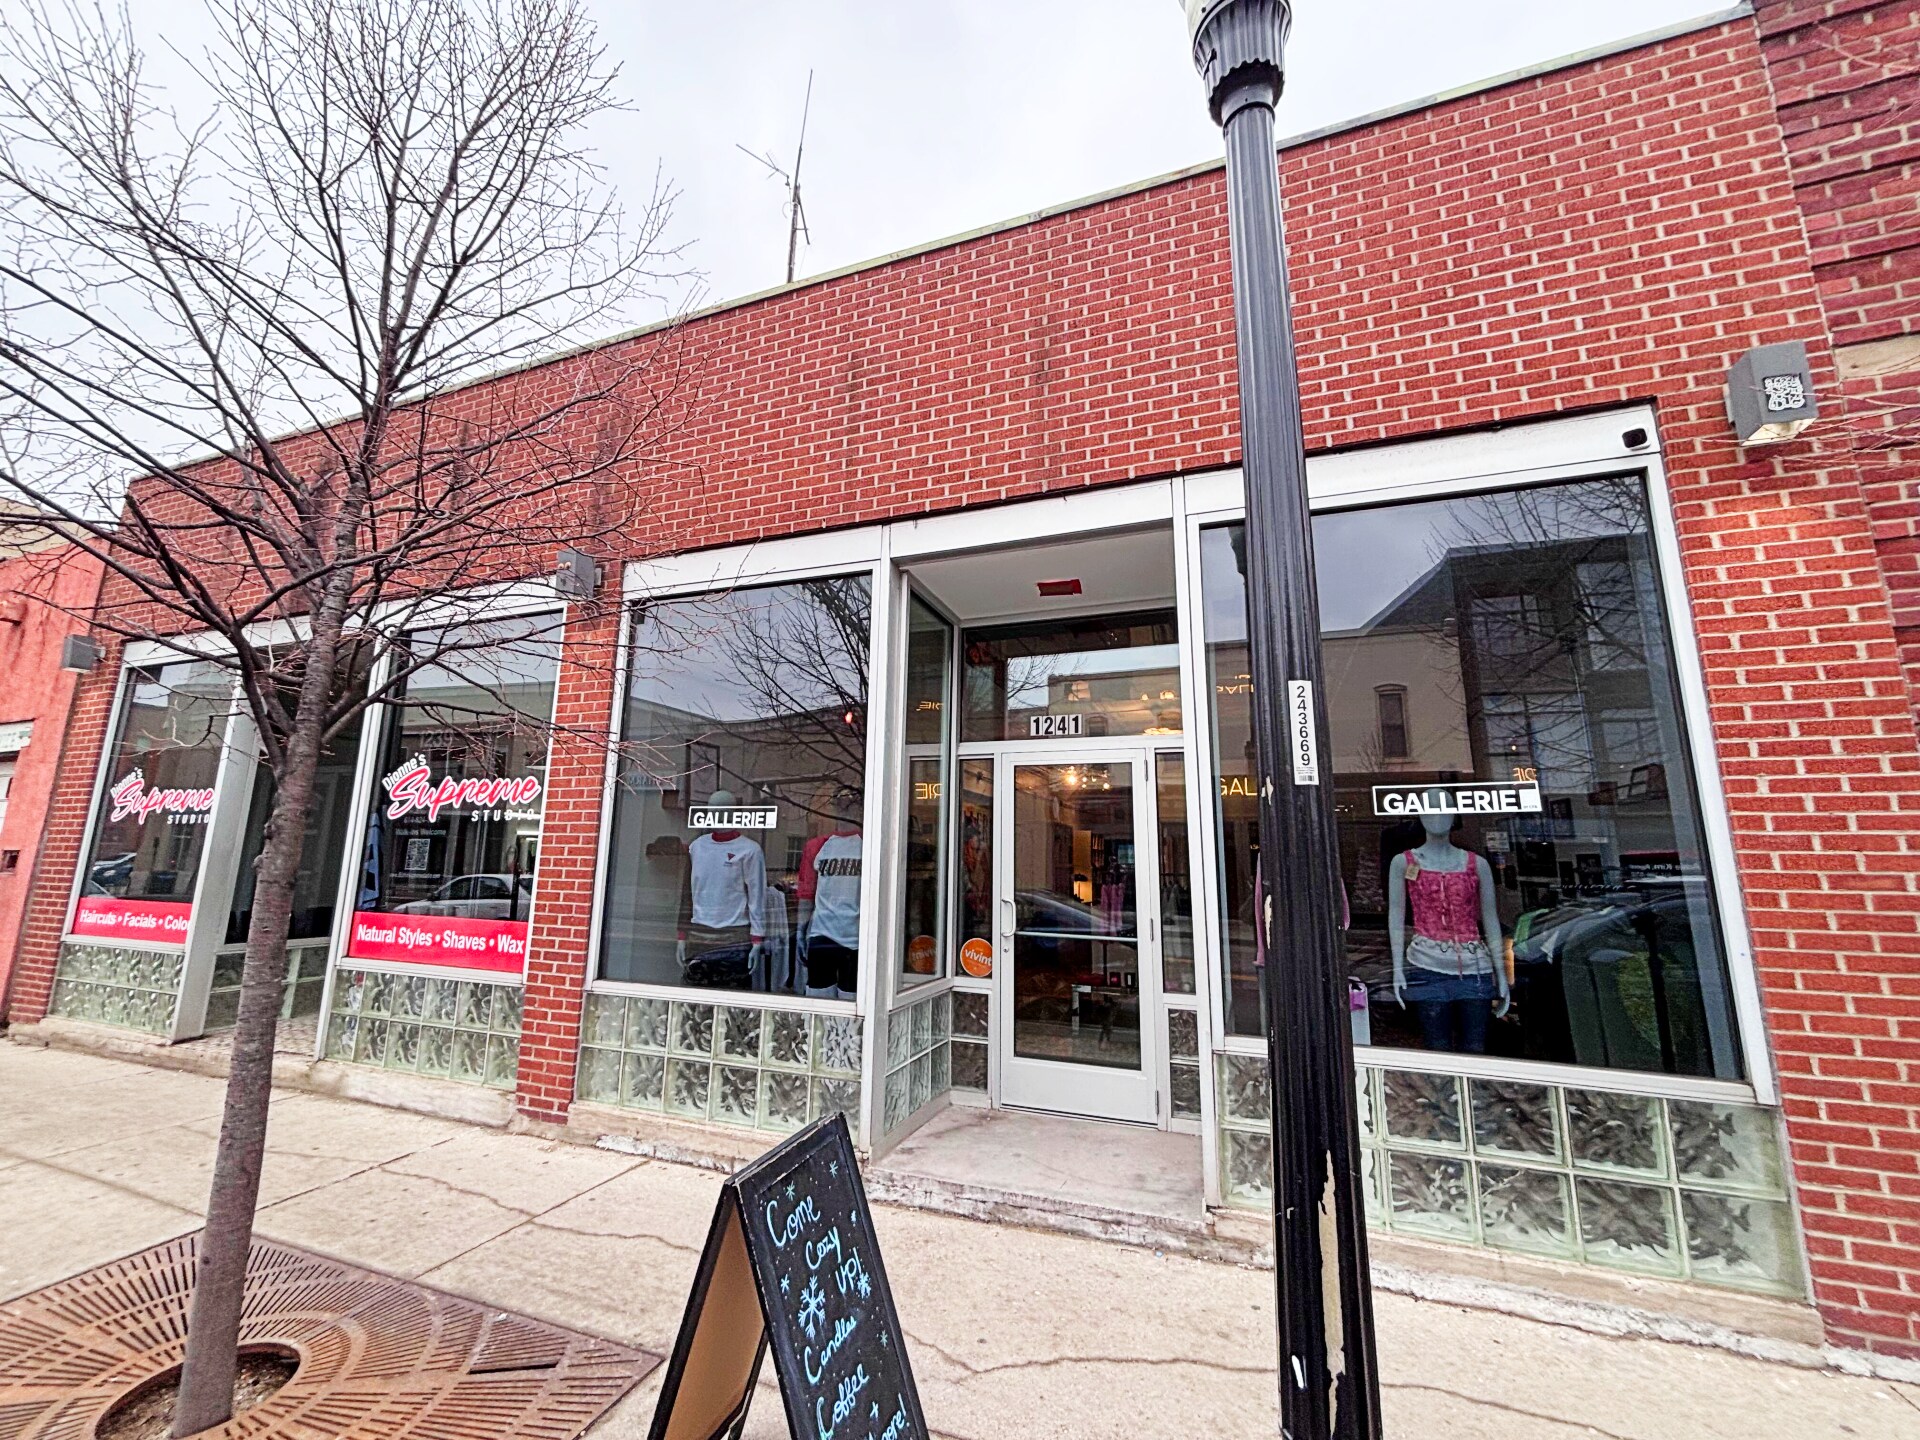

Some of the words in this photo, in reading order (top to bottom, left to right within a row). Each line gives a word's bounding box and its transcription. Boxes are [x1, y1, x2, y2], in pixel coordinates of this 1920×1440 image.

[1033, 715, 1079, 735] 1241
[1296, 685, 1310, 766] 243669
[110, 766, 143, 798] Dionne's
[381, 752, 427, 791] Dionne's
[110, 778, 215, 825] Supreme
[387, 765, 542, 822] Supreme
[1383, 789, 1519, 814] GALLERIE
[166, 814, 210, 824] STUDIO
[471, 808, 535, 821] STUDIO
[693, 810, 766, 827] GALLERIE
[80, 909, 116, 925] Haircuts
[122, 911, 157, 928] Facials
[357, 924, 397, 943] Natural
[398, 927, 433, 949] Styles
[442, 930, 486, 951] Shaves
[497, 934, 526, 955] Wax
[965, 948, 992, 966] vivint
[766, 1195, 821, 1247] Come
[805, 1226, 842, 1270] Cozy
[804, 1315, 857, 1384] Candles
[816, 1363, 870, 1440] Coffee
